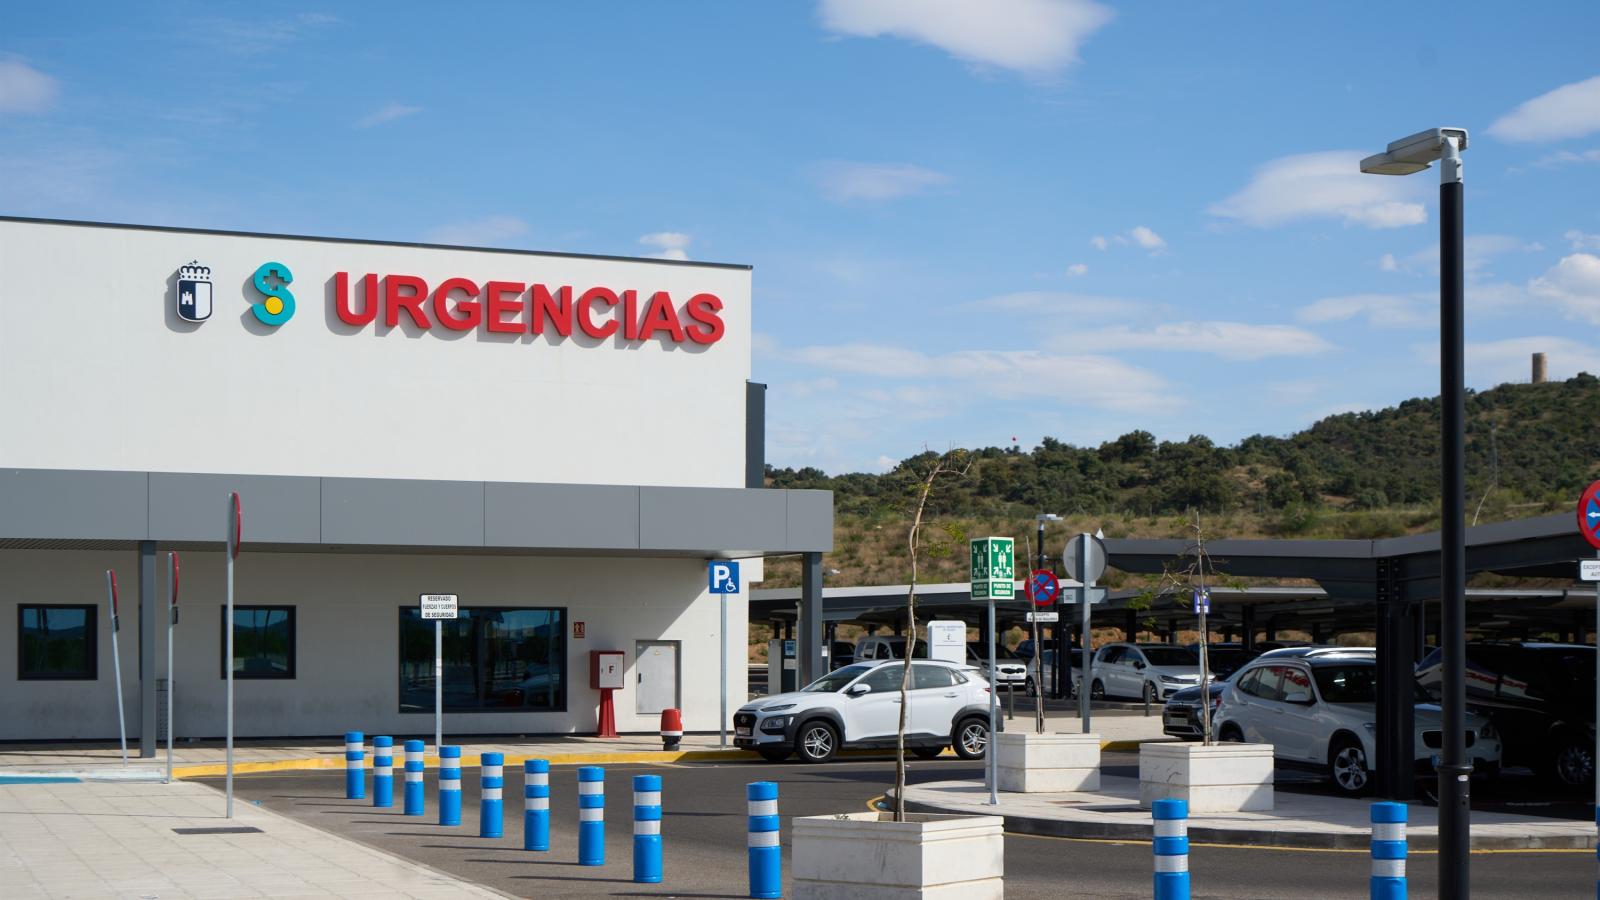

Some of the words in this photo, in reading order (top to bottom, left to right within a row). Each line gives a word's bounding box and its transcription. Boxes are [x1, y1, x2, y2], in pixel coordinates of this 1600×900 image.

[335, 272, 725, 344] URGENCIAS
[714, 565, 730, 588] P
[608, 665, 615, 674] F
